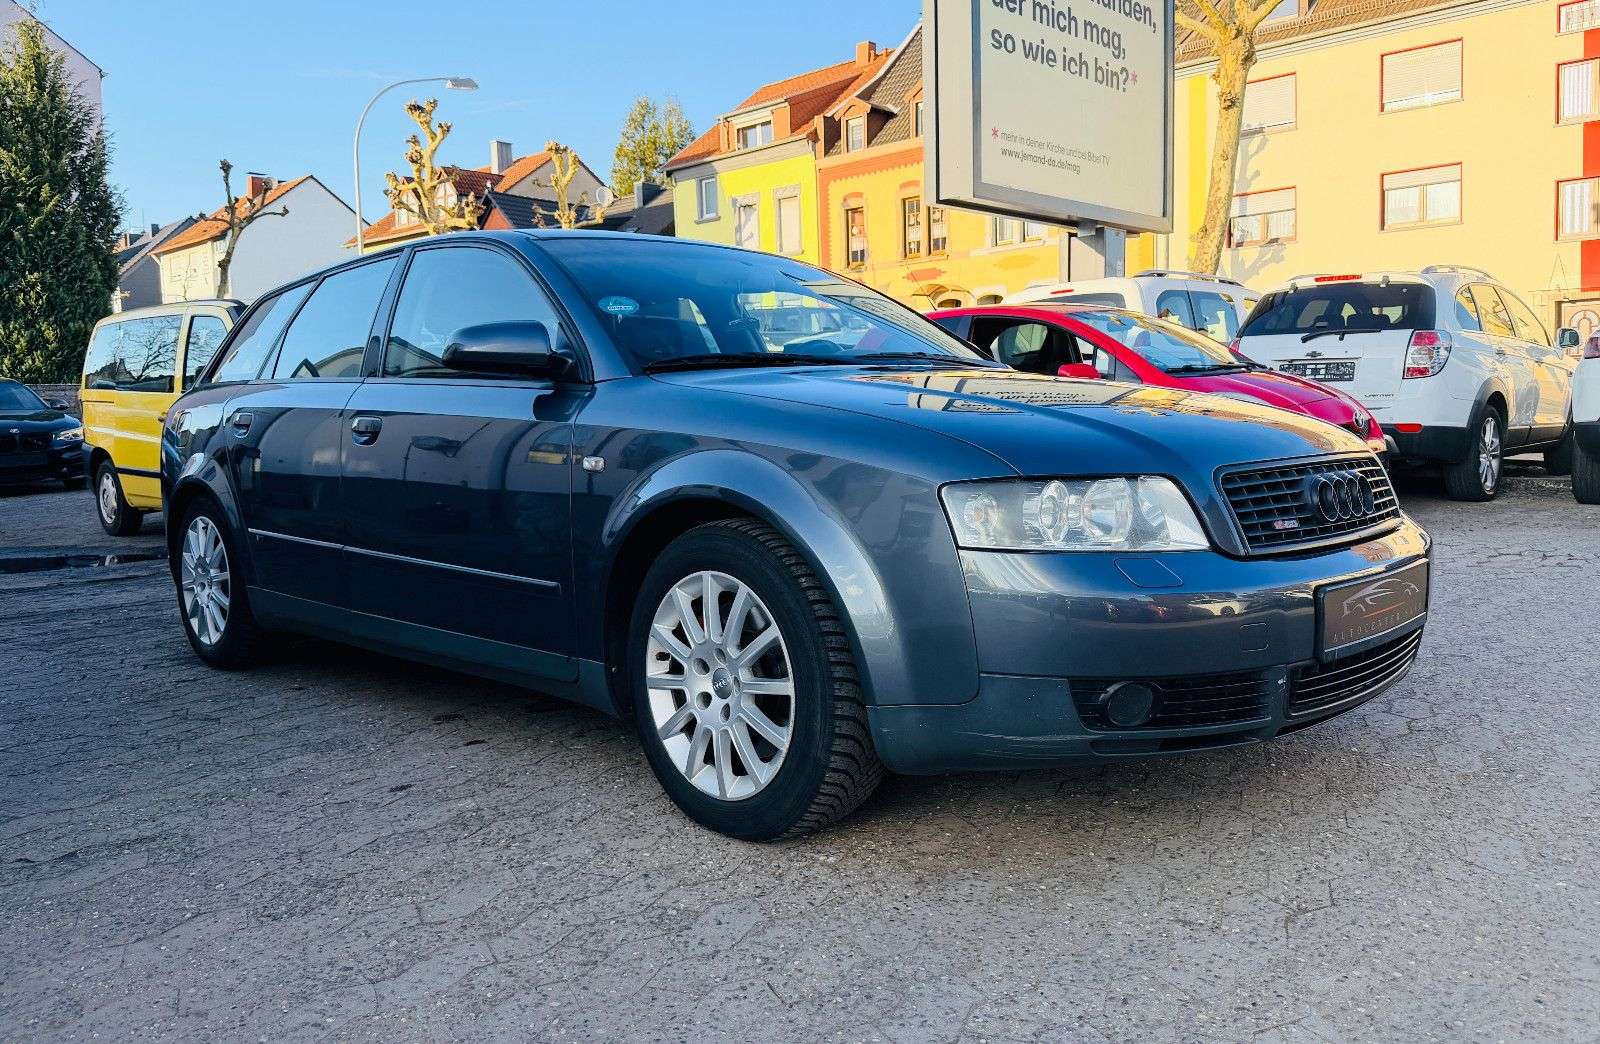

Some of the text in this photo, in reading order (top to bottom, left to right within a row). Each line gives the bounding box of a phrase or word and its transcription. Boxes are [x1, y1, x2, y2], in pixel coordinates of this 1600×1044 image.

[991, 28, 1016, 54] so
[1022, 39, 1057, 68] wie
[1062, 47, 1089, 80] ich
[1032, 0, 1079, 38] mich
[1083, 19, 1126, 60] mag,
[1001, 132, 1018, 143] mehr
[1025, 136, 1046, 150] deiner
